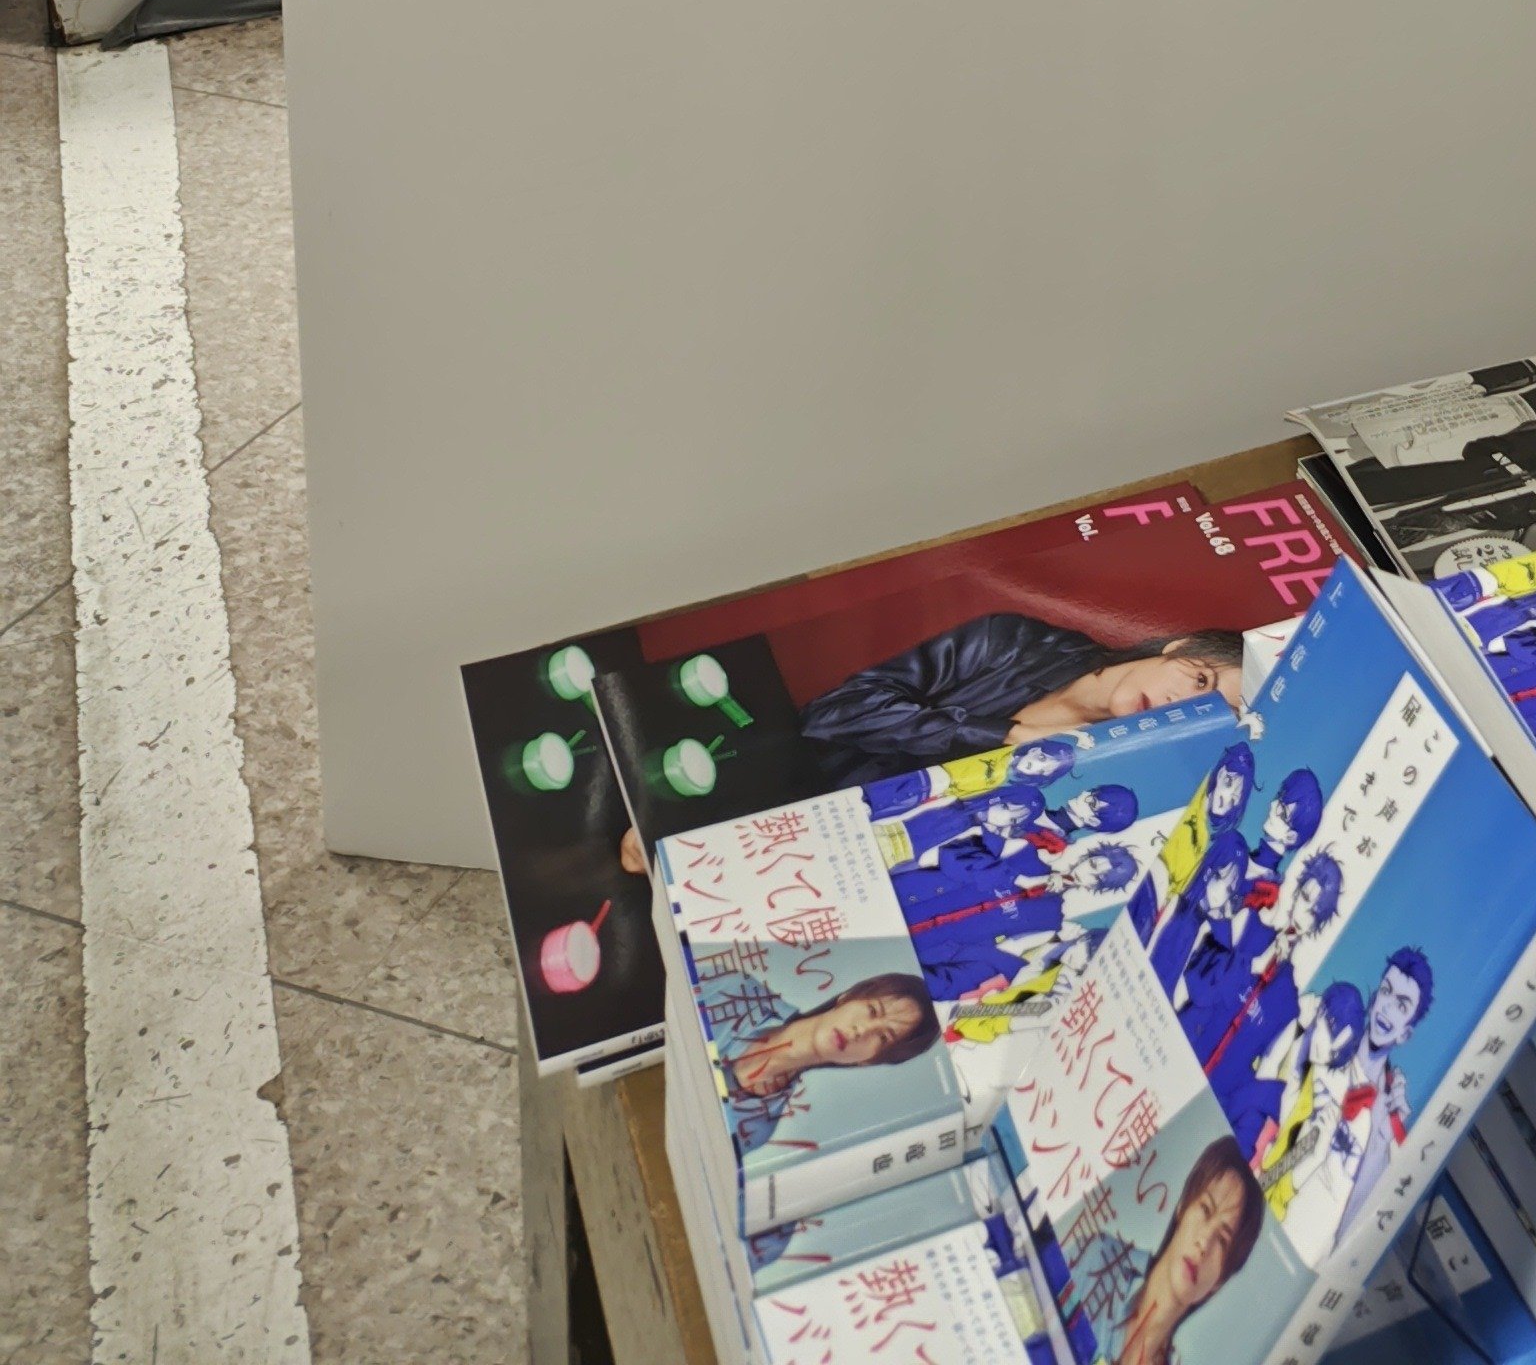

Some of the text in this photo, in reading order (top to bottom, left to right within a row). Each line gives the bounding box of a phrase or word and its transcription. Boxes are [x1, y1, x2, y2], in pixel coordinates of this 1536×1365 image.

[1074, 513, 1099, 543] Vol.
[1102, 500, 1175, 526] F
[1195, 511, 1236, 557] Vol.68
[1340, 692, 1422, 833] 届くまで
[1357, 730, 1443, 860] この声が
[734, 811, 841, 992] 熱くて儚い
[1050, 978, 1169, 1213] 熱くて儚い
